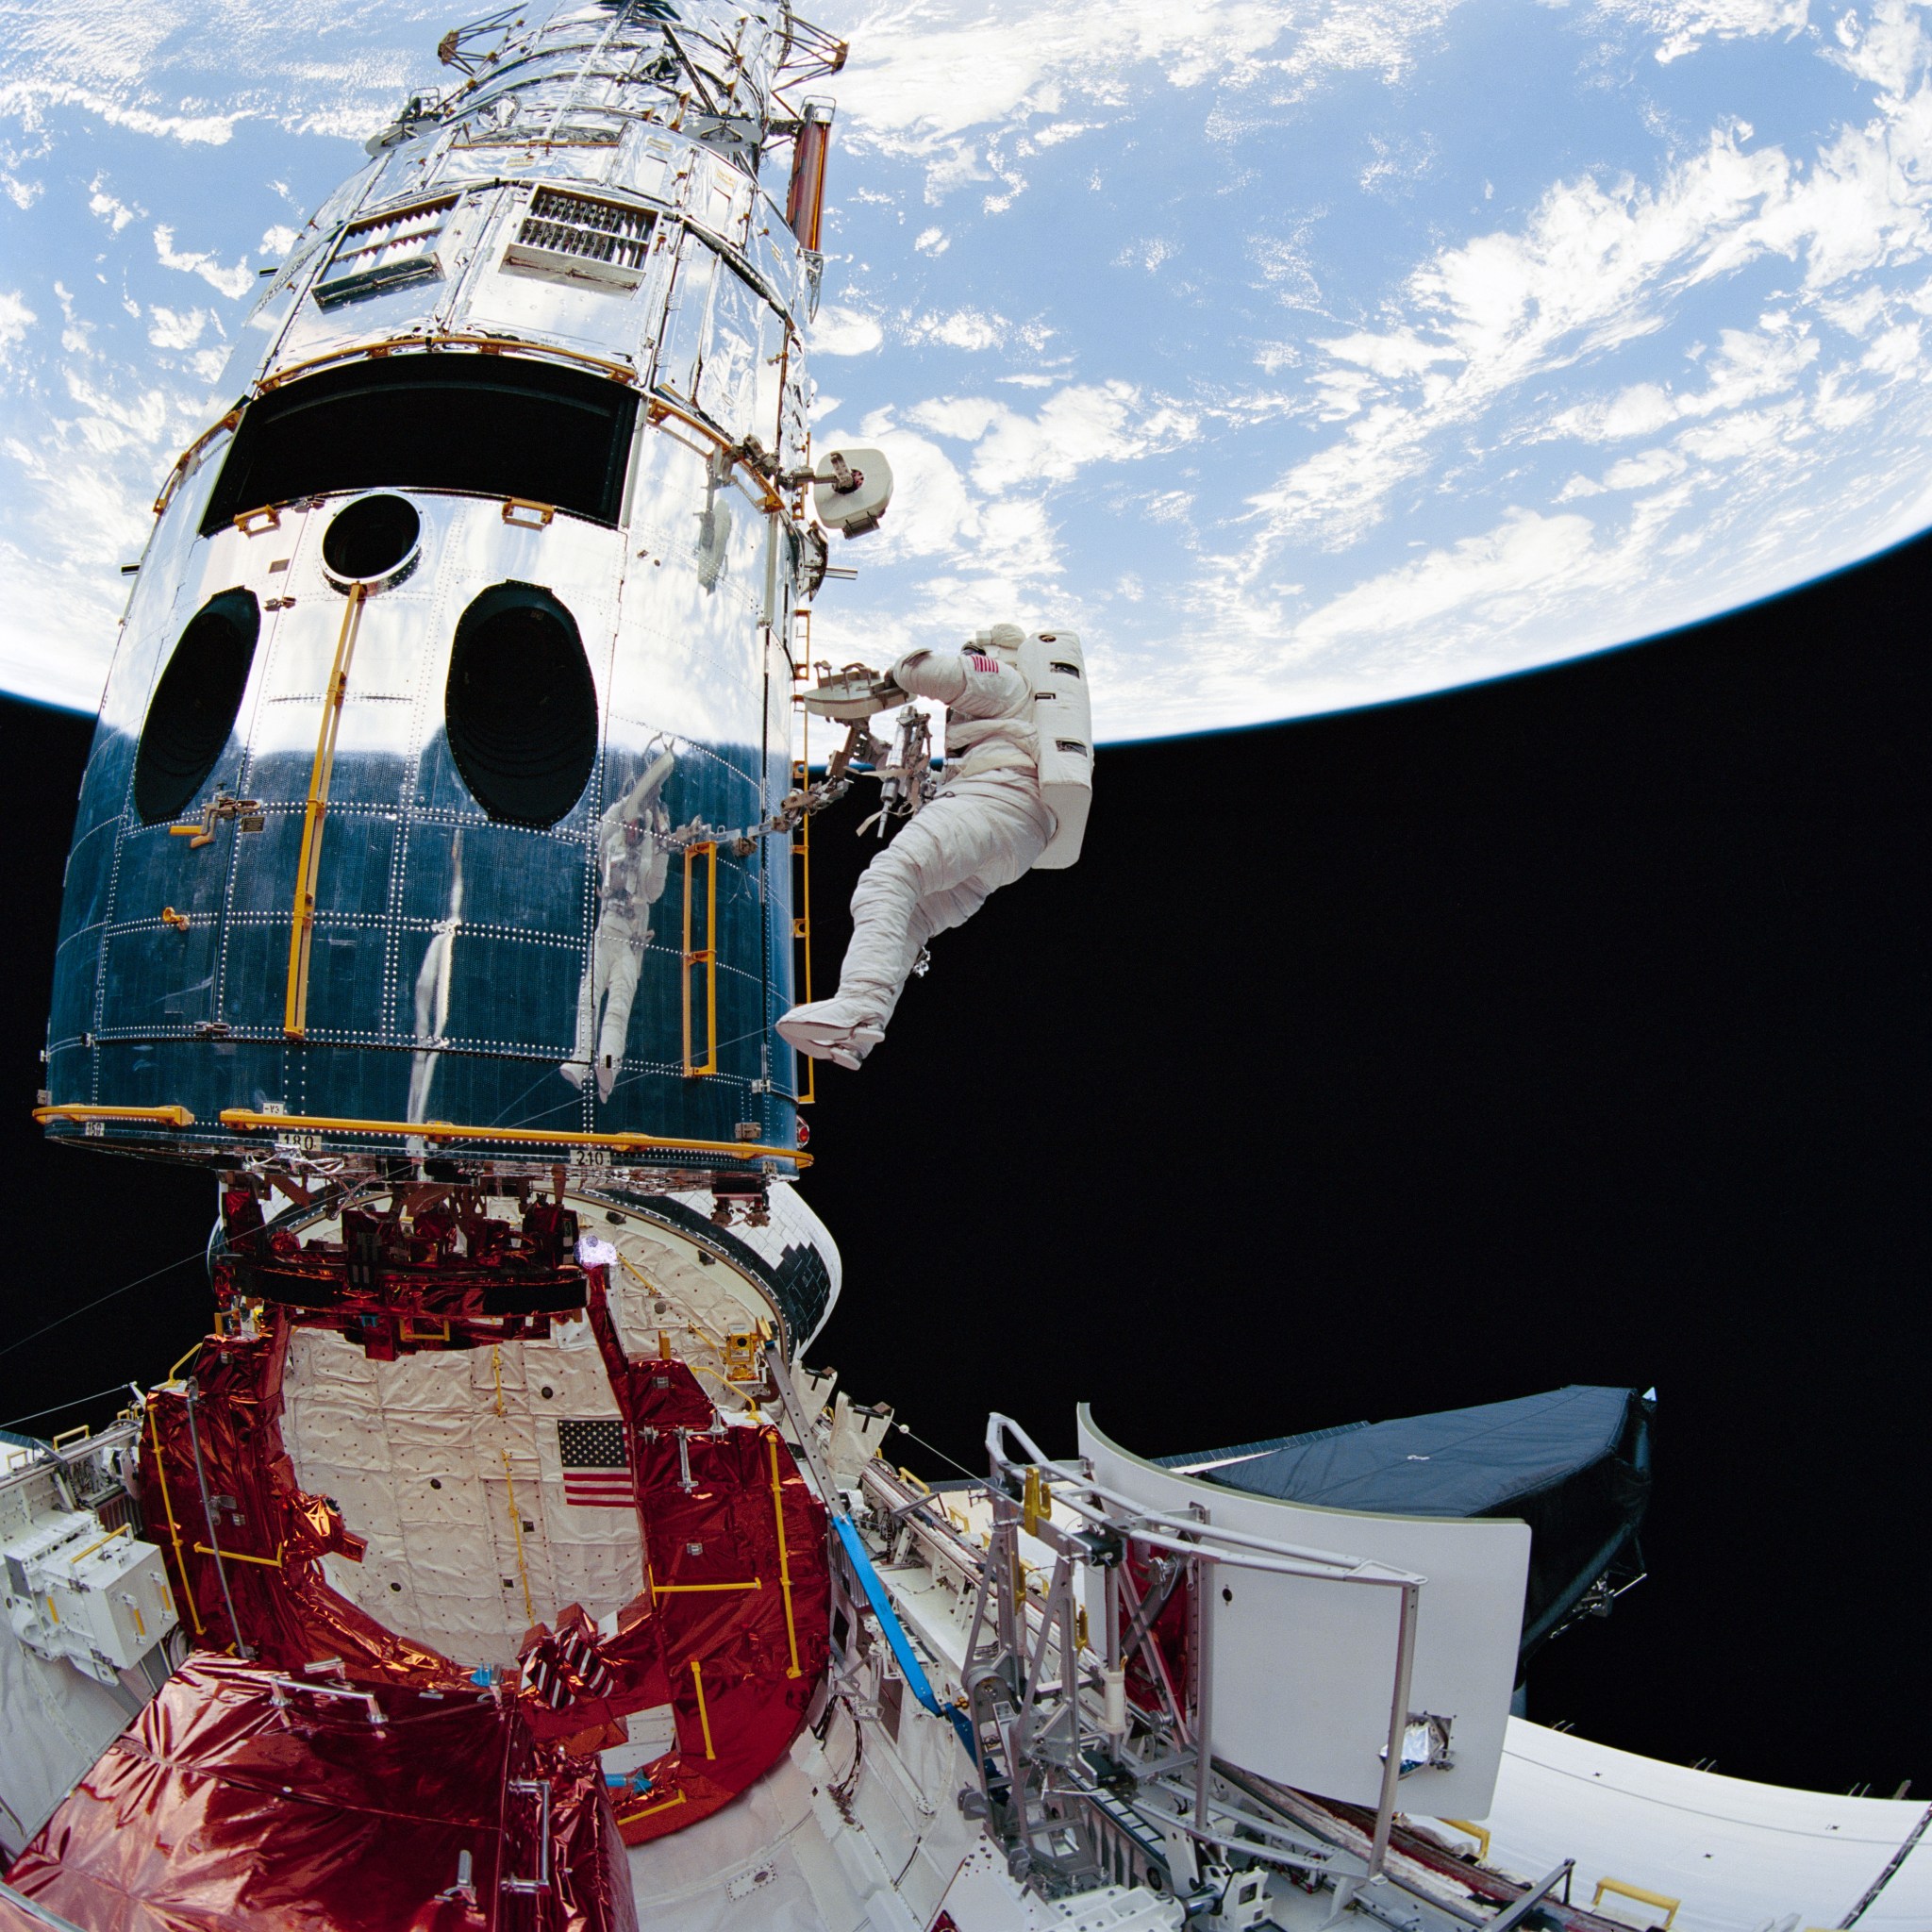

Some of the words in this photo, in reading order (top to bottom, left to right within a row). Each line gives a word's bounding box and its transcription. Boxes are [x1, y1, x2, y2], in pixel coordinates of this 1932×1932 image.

[264, 1105, 280, 1114] -V3
[88, 1123, 102, 1136] 150
[284, 1134, 314, 1151] 180
[576, 1150, 604, 1166] 210
